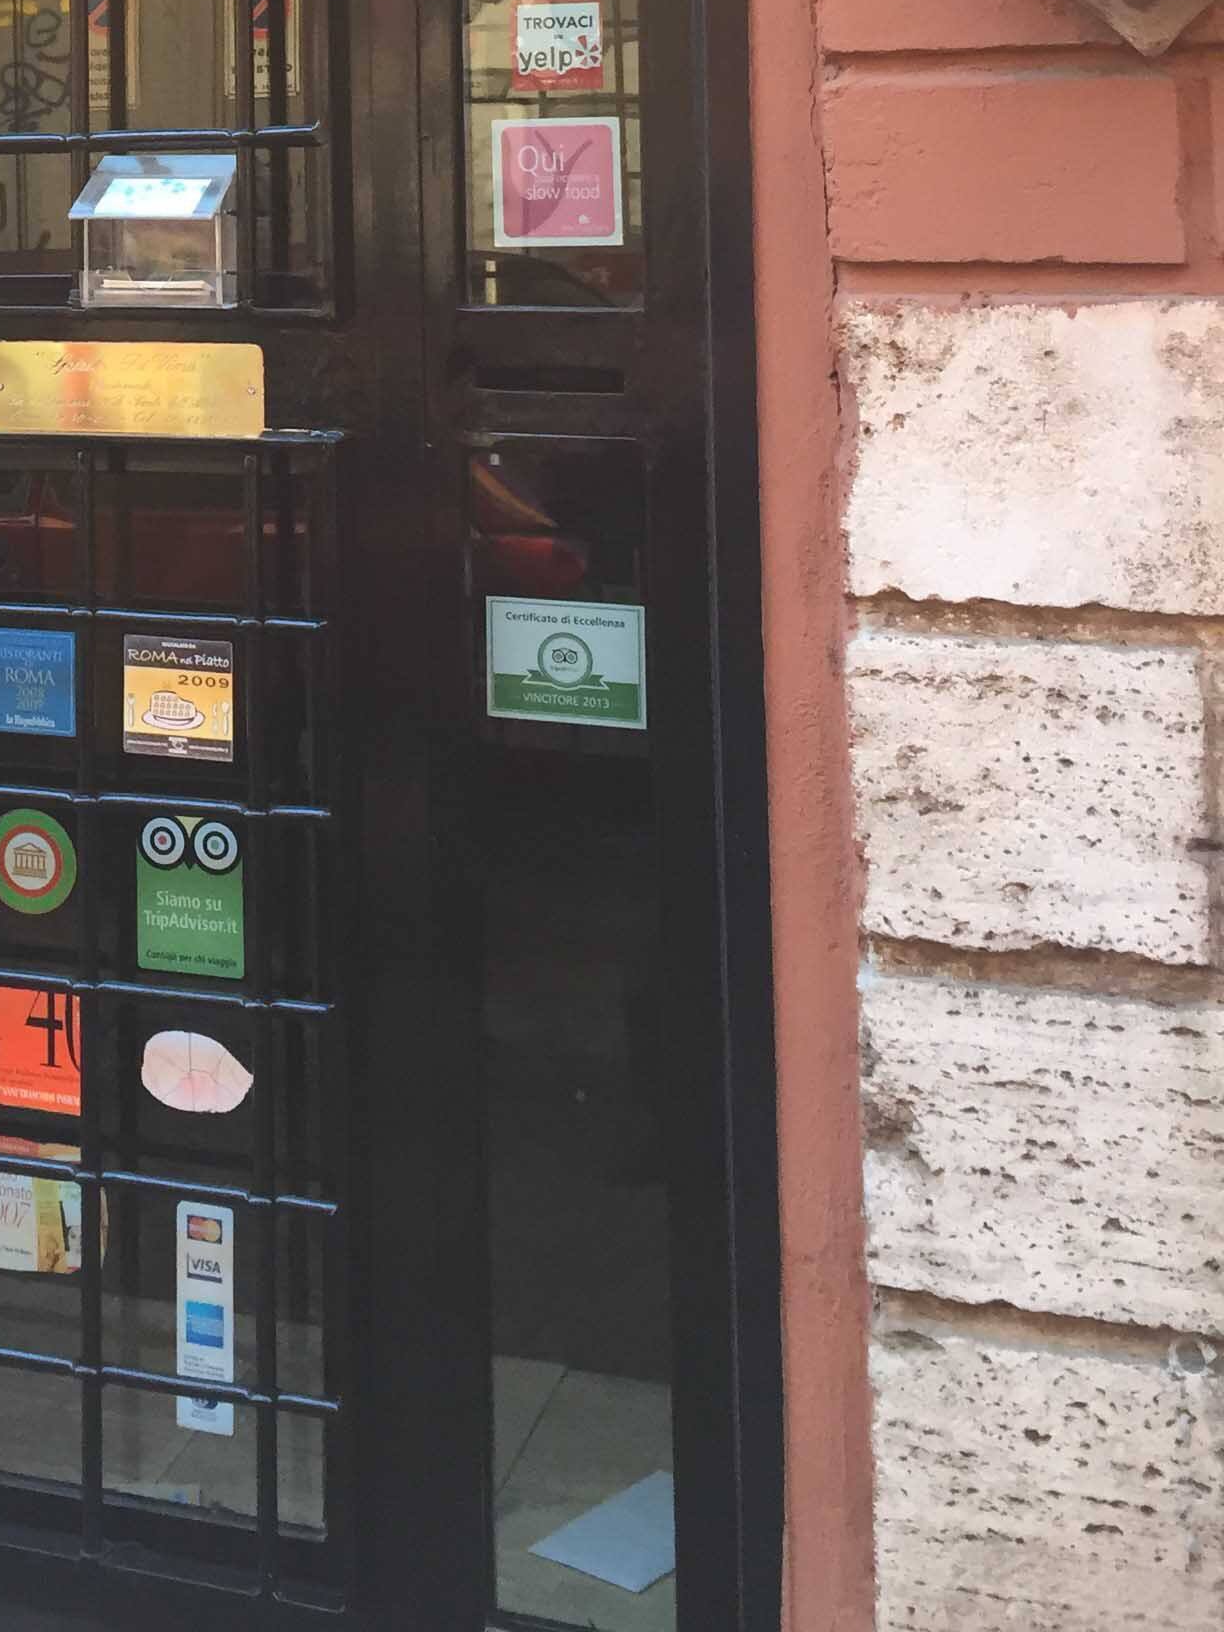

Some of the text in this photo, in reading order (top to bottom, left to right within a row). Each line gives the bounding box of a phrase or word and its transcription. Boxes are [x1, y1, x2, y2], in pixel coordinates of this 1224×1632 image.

[522, 15, 594, 30] TROVACI
[518, 46, 574, 72] yelp
[518, 143, 565, 177] Qui
[526, 183, 601, 201] slow food
[505, 611, 626, 629] Certificato di Eccellenza
[127, 648, 178, 665] ROMA
[194, 653, 230, 668] Piatto
[4, 666, 56, 687] ROMA
[178, 674, 230, 689] 2009
[522, 692, 611, 710] VINCITORE 2013
[156, 890, 223, 912] Siamo su
[144, 909, 239, 935] TripAdvisor.it
[191, 1258, 222, 1274] VISA
